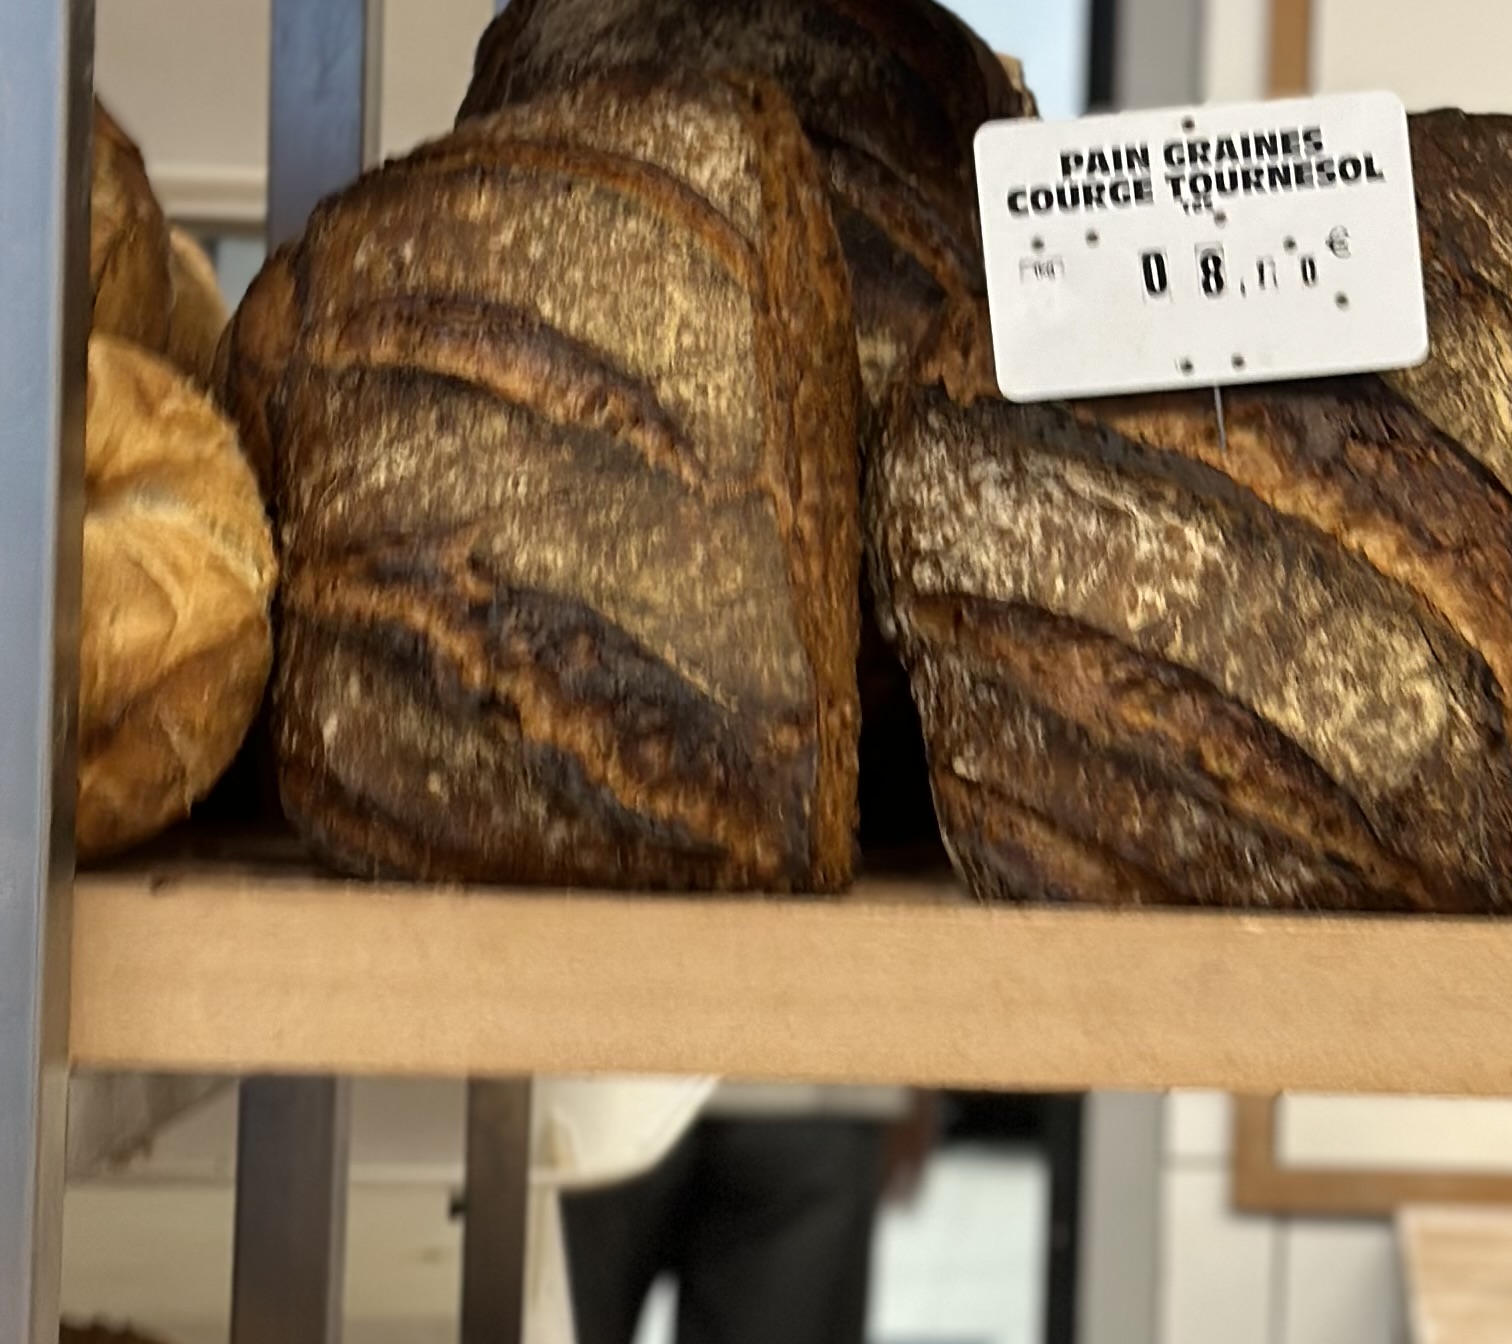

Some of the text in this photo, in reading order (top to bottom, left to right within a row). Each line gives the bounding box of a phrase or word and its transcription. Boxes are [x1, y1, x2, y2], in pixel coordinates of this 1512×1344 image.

[1058, 125, 1326, 180] PAIN GRAINES
[1005, 177, 1156, 218] COURGE
[1163, 152, 1388, 202] TOURNESOL
